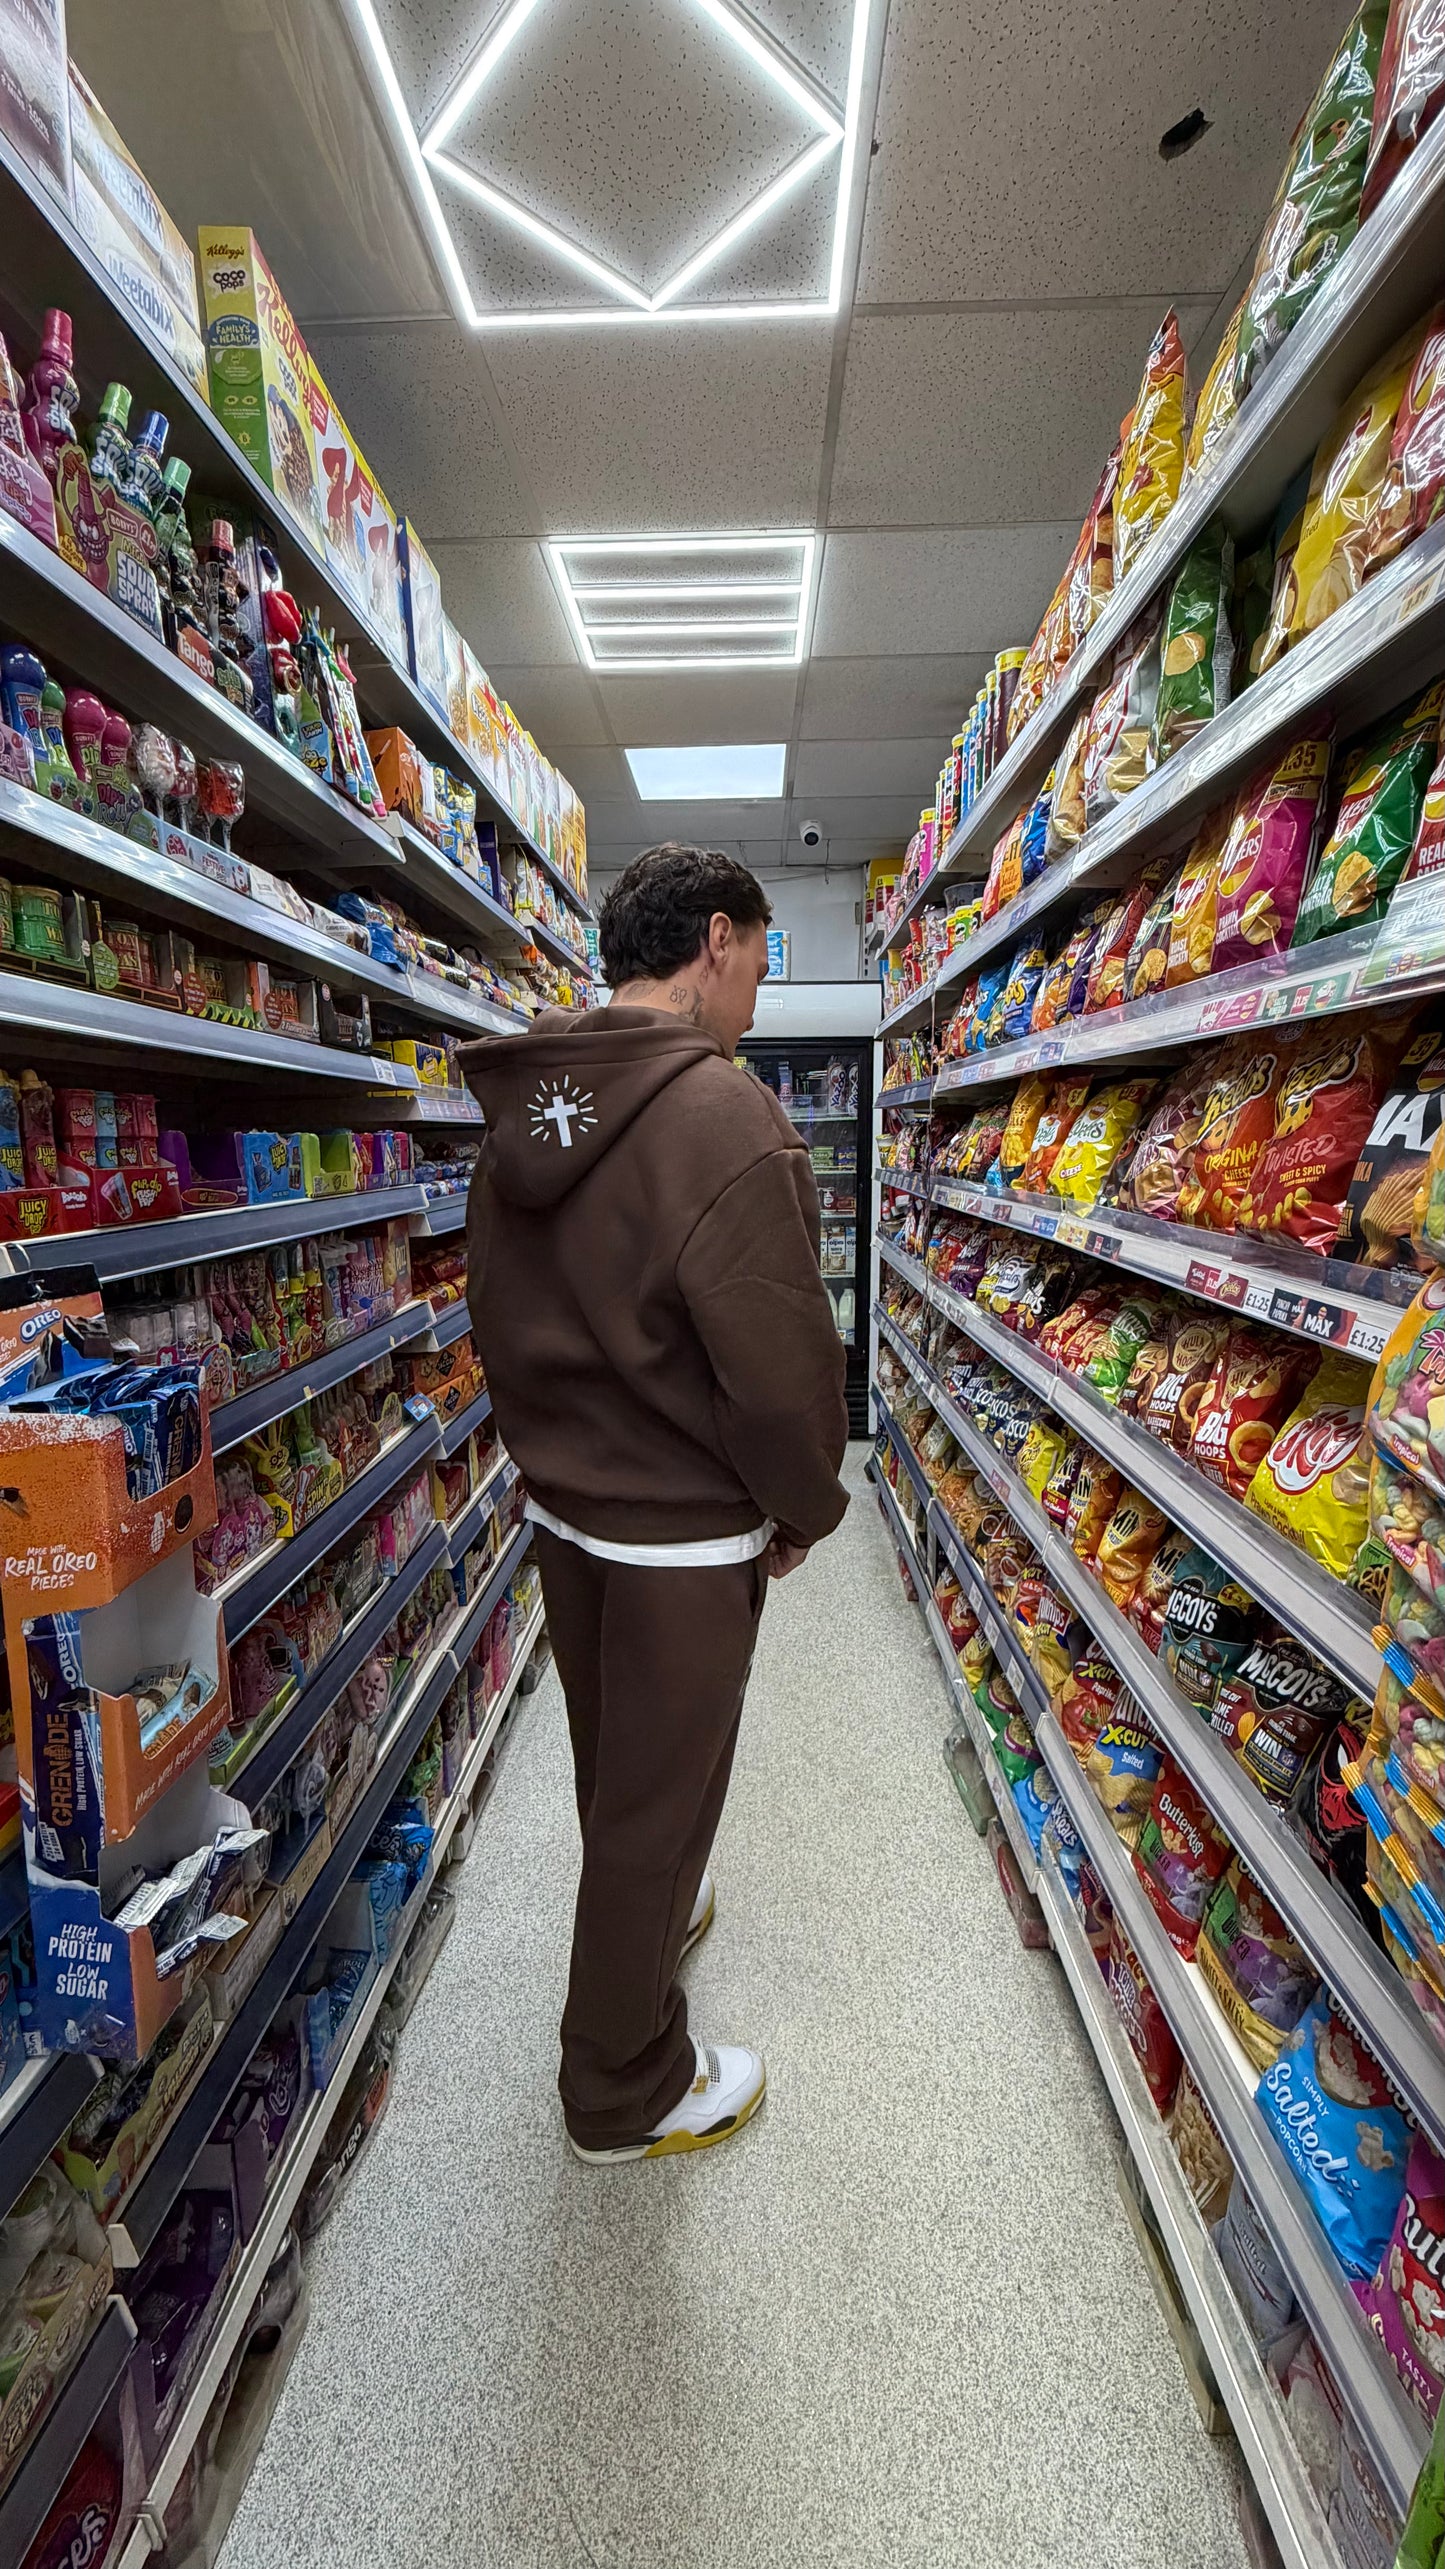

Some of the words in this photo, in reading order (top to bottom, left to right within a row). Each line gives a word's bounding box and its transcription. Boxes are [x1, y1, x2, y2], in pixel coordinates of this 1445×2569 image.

[206, 243, 245, 258] Kellogg's
[107, 249, 176, 334] Weetabix
[215, 322, 251, 336] FAMILY'S
[219, 332, 251, 344] HEALTH
[117, 550, 157, 598] SOUR
[118, 577, 157, 623] SPRAY
[178, 635, 215, 680] Tango
[830, 1071, 847, 1107] YAZOO
[1263, 1133, 1337, 1175] TWISTED
[1302, 1163, 1327, 1177] SPICY
[20, 1198, 48, 1217] JUICY
[24, 1213, 46, 1227] DROP
[31, 1224, 42, 1234] POP
[20, 1308, 61, 1339] OREO
[1303, 1313, 1334, 1338] MAX
[1180, 1334, 1205, 1348] HULA
[1152, 1372, 1188, 1402] BIG
[1149, 1398, 1177, 1413] HOOPS
[1195, 1409, 1234, 1447] BIG
[1193, 1442, 1227, 1460] HOOPS
[1393, 1434, 1420, 1465] Tropical
[1251, 1491, 1272, 1522] Prawn
[1271, 1513, 1307, 1545] Cocktail
[27, 1545, 49, 1556] MADE
[50, 1544, 67, 1554] WITH
[1386, 1535, 1416, 1567] Tropical
[5, 1556, 48, 1578] REAL
[52, 1551, 98, 1574] OREO
[30, 1574, 75, 1591] PIECES
[56, 1631, 77, 1684] OREO
[1092, 1681, 1117, 1701] Paprika
[73, 1729, 83, 1749] SUGAR
[1100, 1723, 1150, 1749] X-CUT
[1254, 1728, 1283, 1759] WIN
[43, 1712, 74, 1828] GRENADE
[74, 1749, 85, 1766] LOW
[134, 1782, 157, 1812] MADE
[175, 1742, 192, 1768] REAL
[192, 1723, 209, 1749] OREO
[208, 1701, 228, 1730] PIECES
[1121, 1751, 1144, 1770] Salted
[77, 1794, 88, 1811] HIGH
[1158, 1792, 1205, 1858] Butterkist
[60, 1923, 98, 1943] HIGH
[48, 1936, 113, 1964] PROTEIN
[66, 1961, 99, 1978] LOW
[55, 1973, 109, 2000] SUGAR
[1228, 1987, 1250, 2030] SALTY
[1301, 2076, 1330, 2117] SIMPLY
[1265, 2061, 1349, 2183] Salted
[1275, 2117, 1310, 2173] POPCORN
[1400, 2346, 1435, 2401] TASTY
